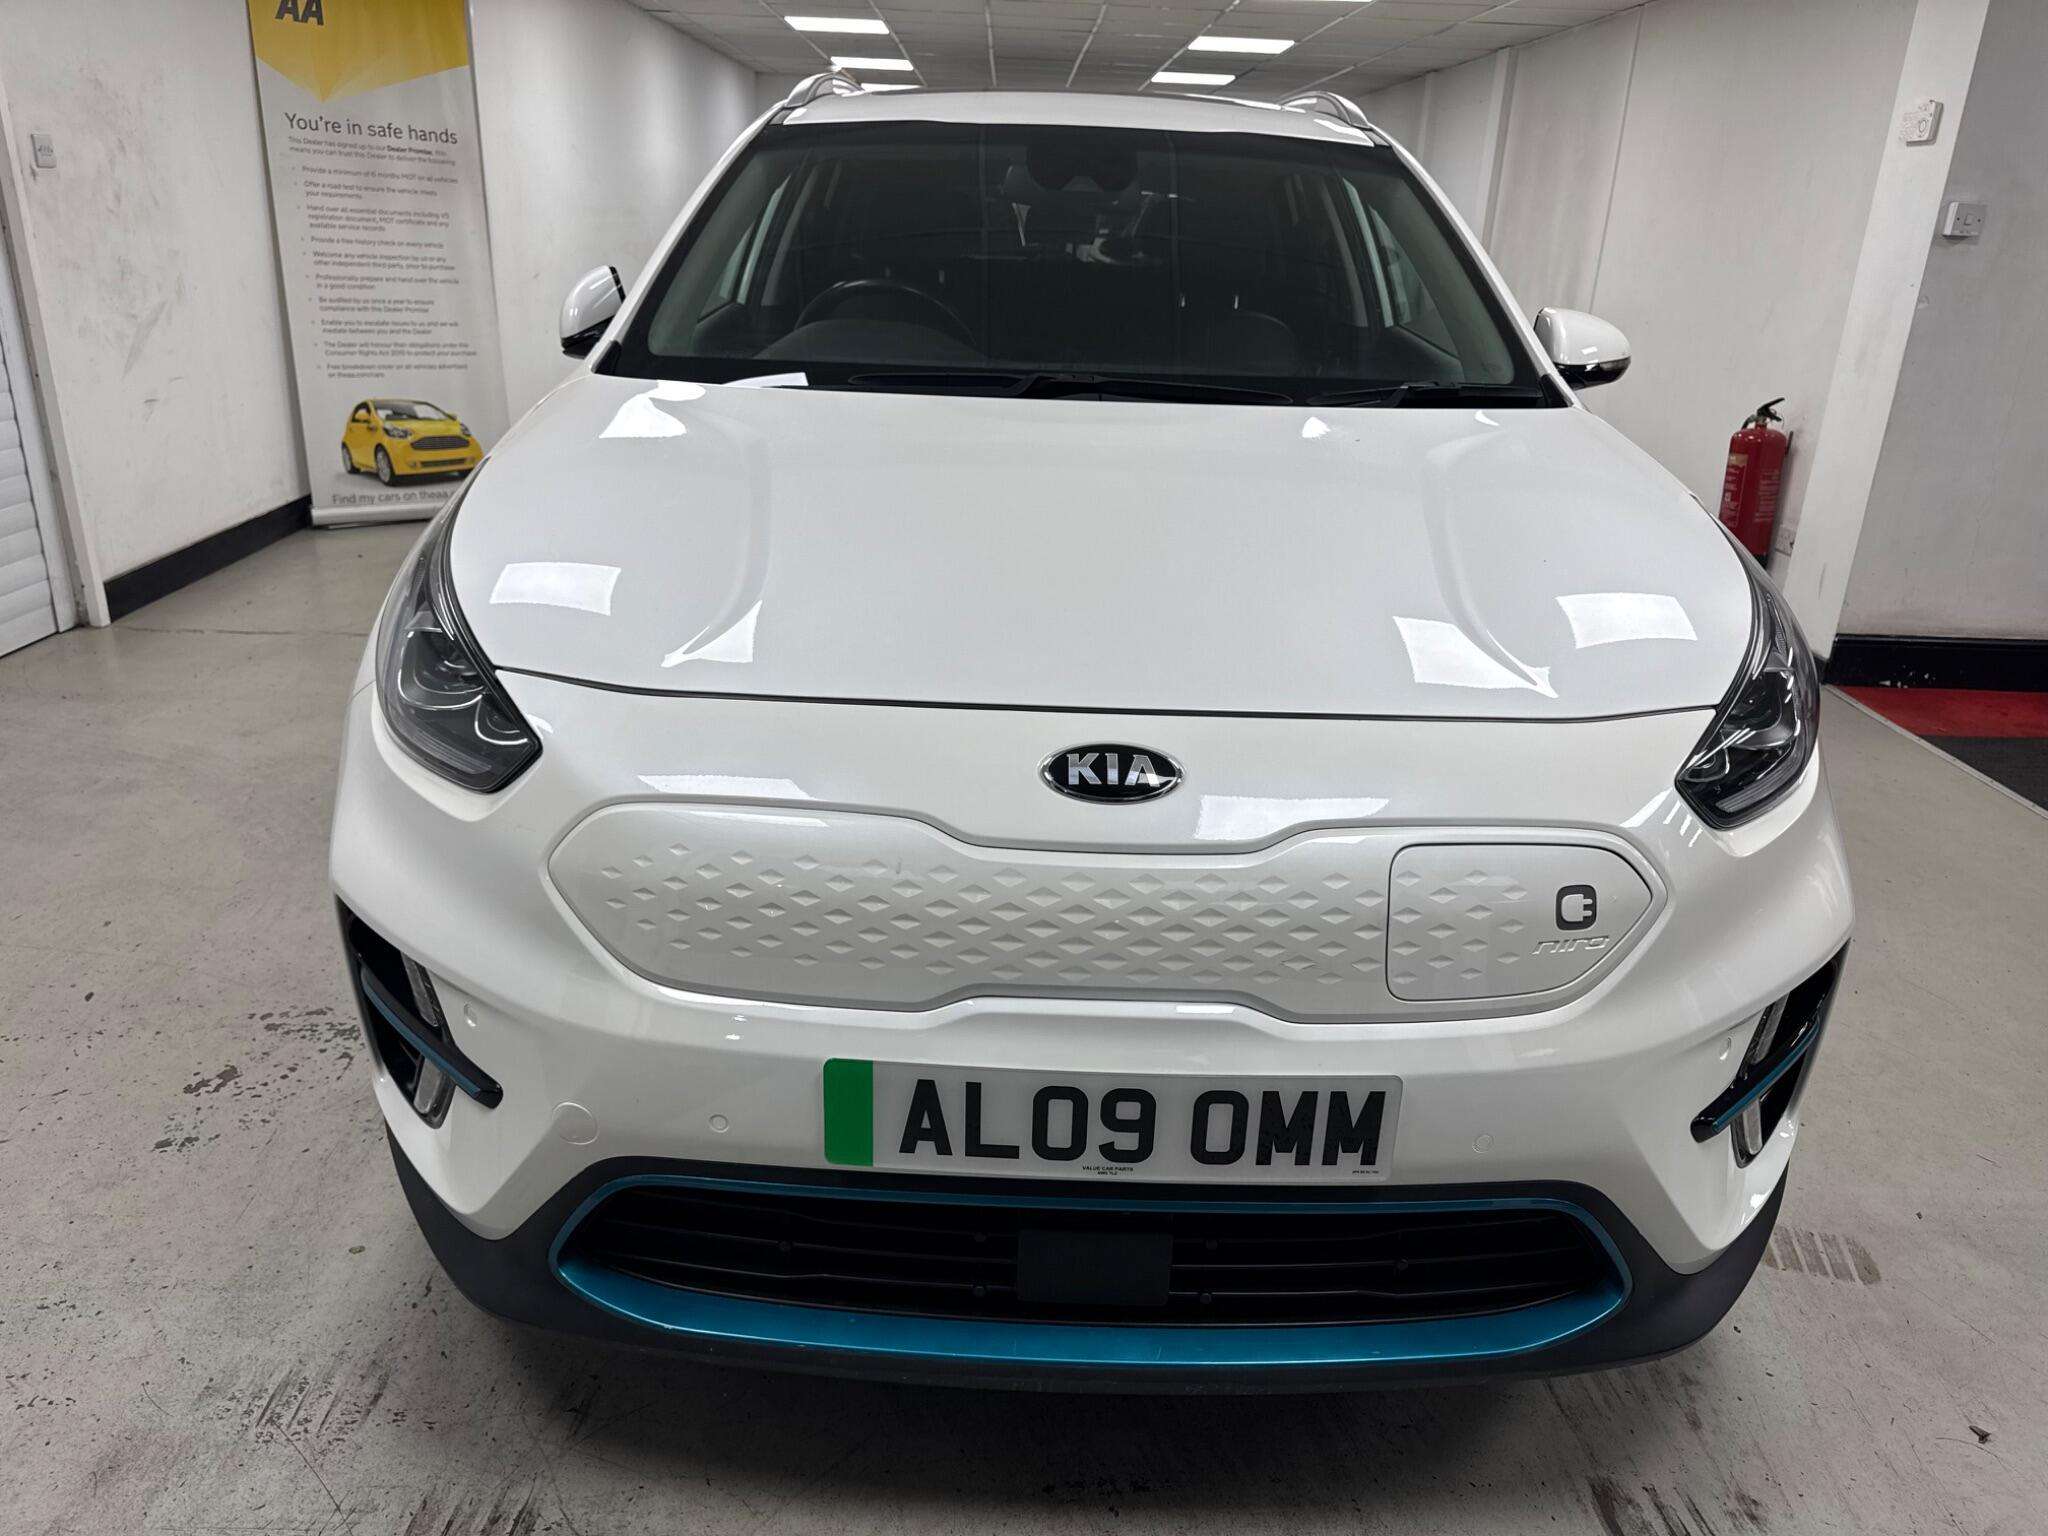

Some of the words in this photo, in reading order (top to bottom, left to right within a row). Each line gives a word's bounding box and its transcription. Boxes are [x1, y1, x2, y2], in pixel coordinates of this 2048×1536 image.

[284, 112, 342, 134] You're
[346, 118, 363, 136] in
[368, 122, 403, 139] safe
[408, 125, 458, 145] hands
[332, 494, 357, 504] Find
[358, 494, 375, 506] my
[378, 492, 399, 502] cars
[402, 491, 417, 500] on
[1066, 752, 1160, 787] KIA
[898, 1078, 1157, 1164] AL09
[1189, 1089, 1386, 1167] OMM
